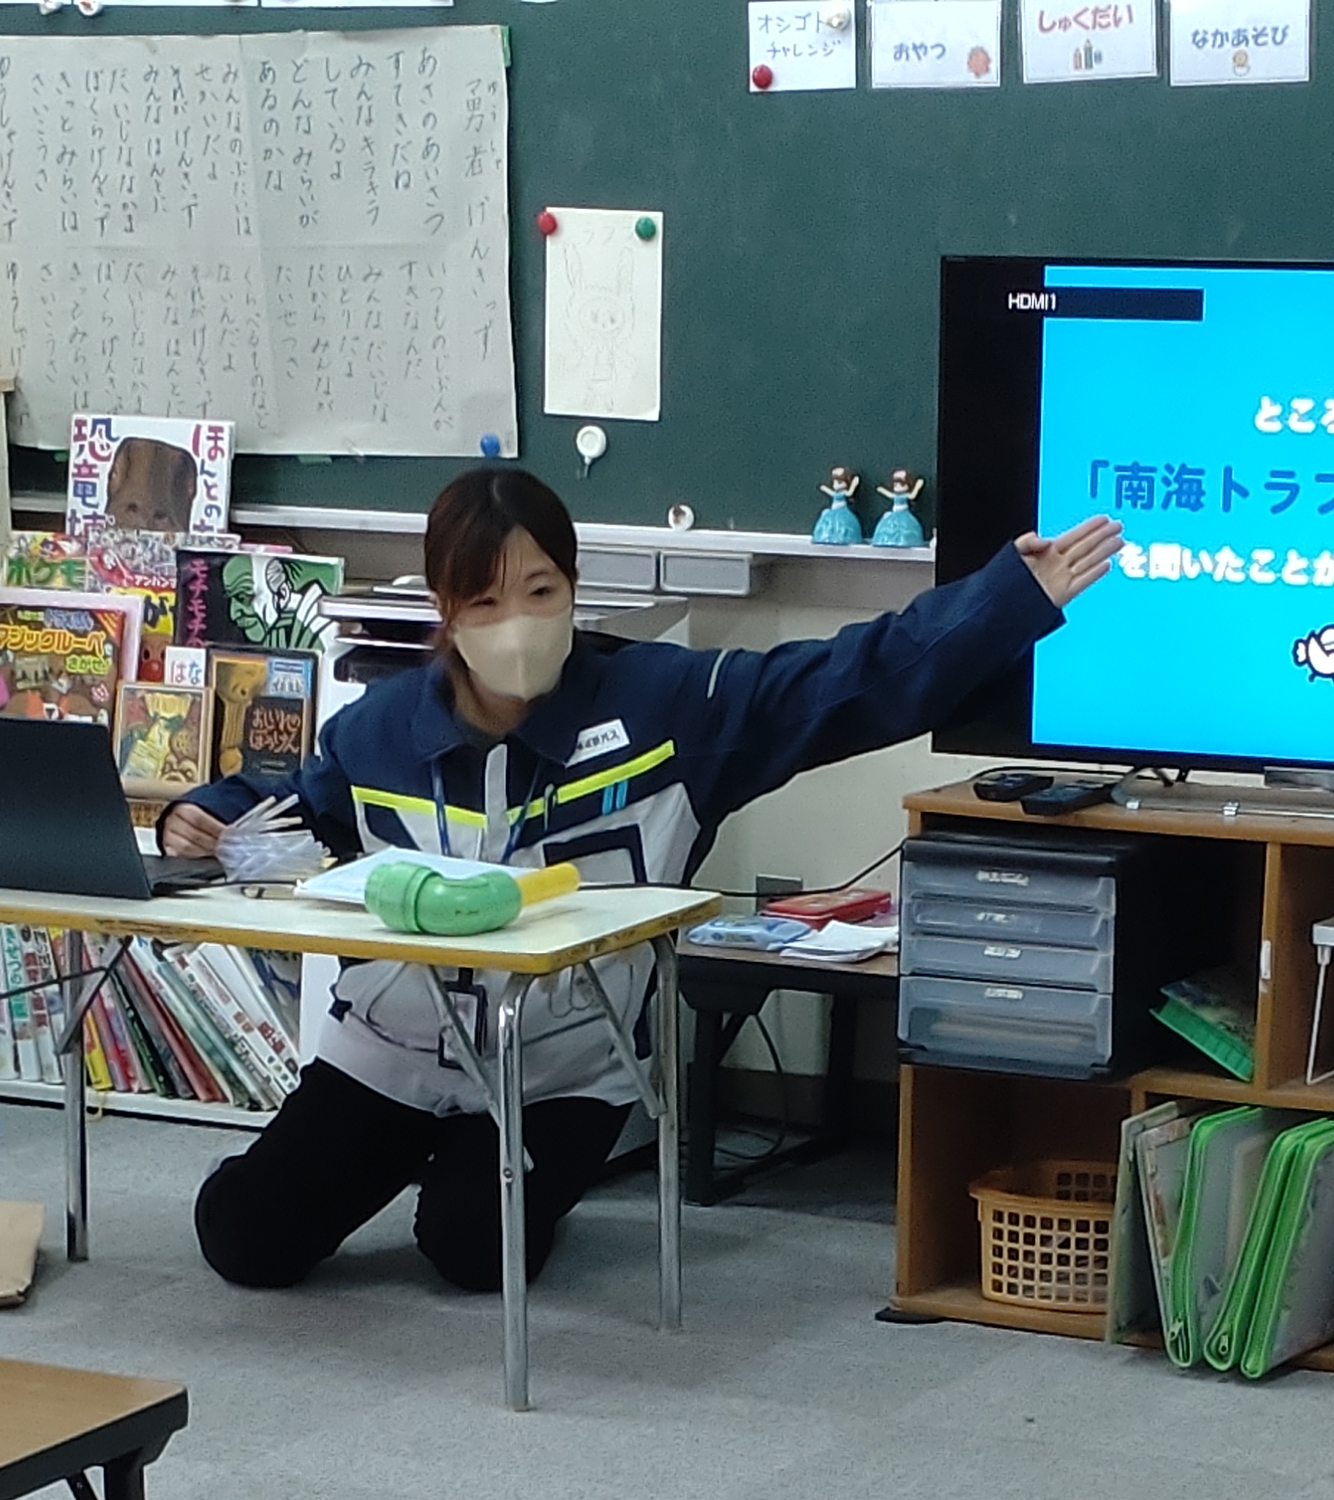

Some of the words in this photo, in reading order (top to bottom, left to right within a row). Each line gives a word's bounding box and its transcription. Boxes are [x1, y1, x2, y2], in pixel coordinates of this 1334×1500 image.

[757, 12, 825, 33] オシゴト
[767, 40, 842, 59] チャレンジ
[893, 42, 947, 62] おやつ
[1038, 5, 1134, 32] しゅくだい
[1191, 25, 1289, 50] なかあそび
[194, 63, 222, 181] せかいだよ
[259, 60, 286, 192] あるのかな
[290, 57, 320, 229] どんなみらいが
[324, 56, 347, 181] しているよ
[349, 54, 380, 227] みんなキラキラ
[386, 50, 413, 190] すてきだね
[417, 46, 445, 236] あさのあいさつ
[398, 260, 423, 381] すきなんだ
[1008, 292, 1057, 311] HDMI1
